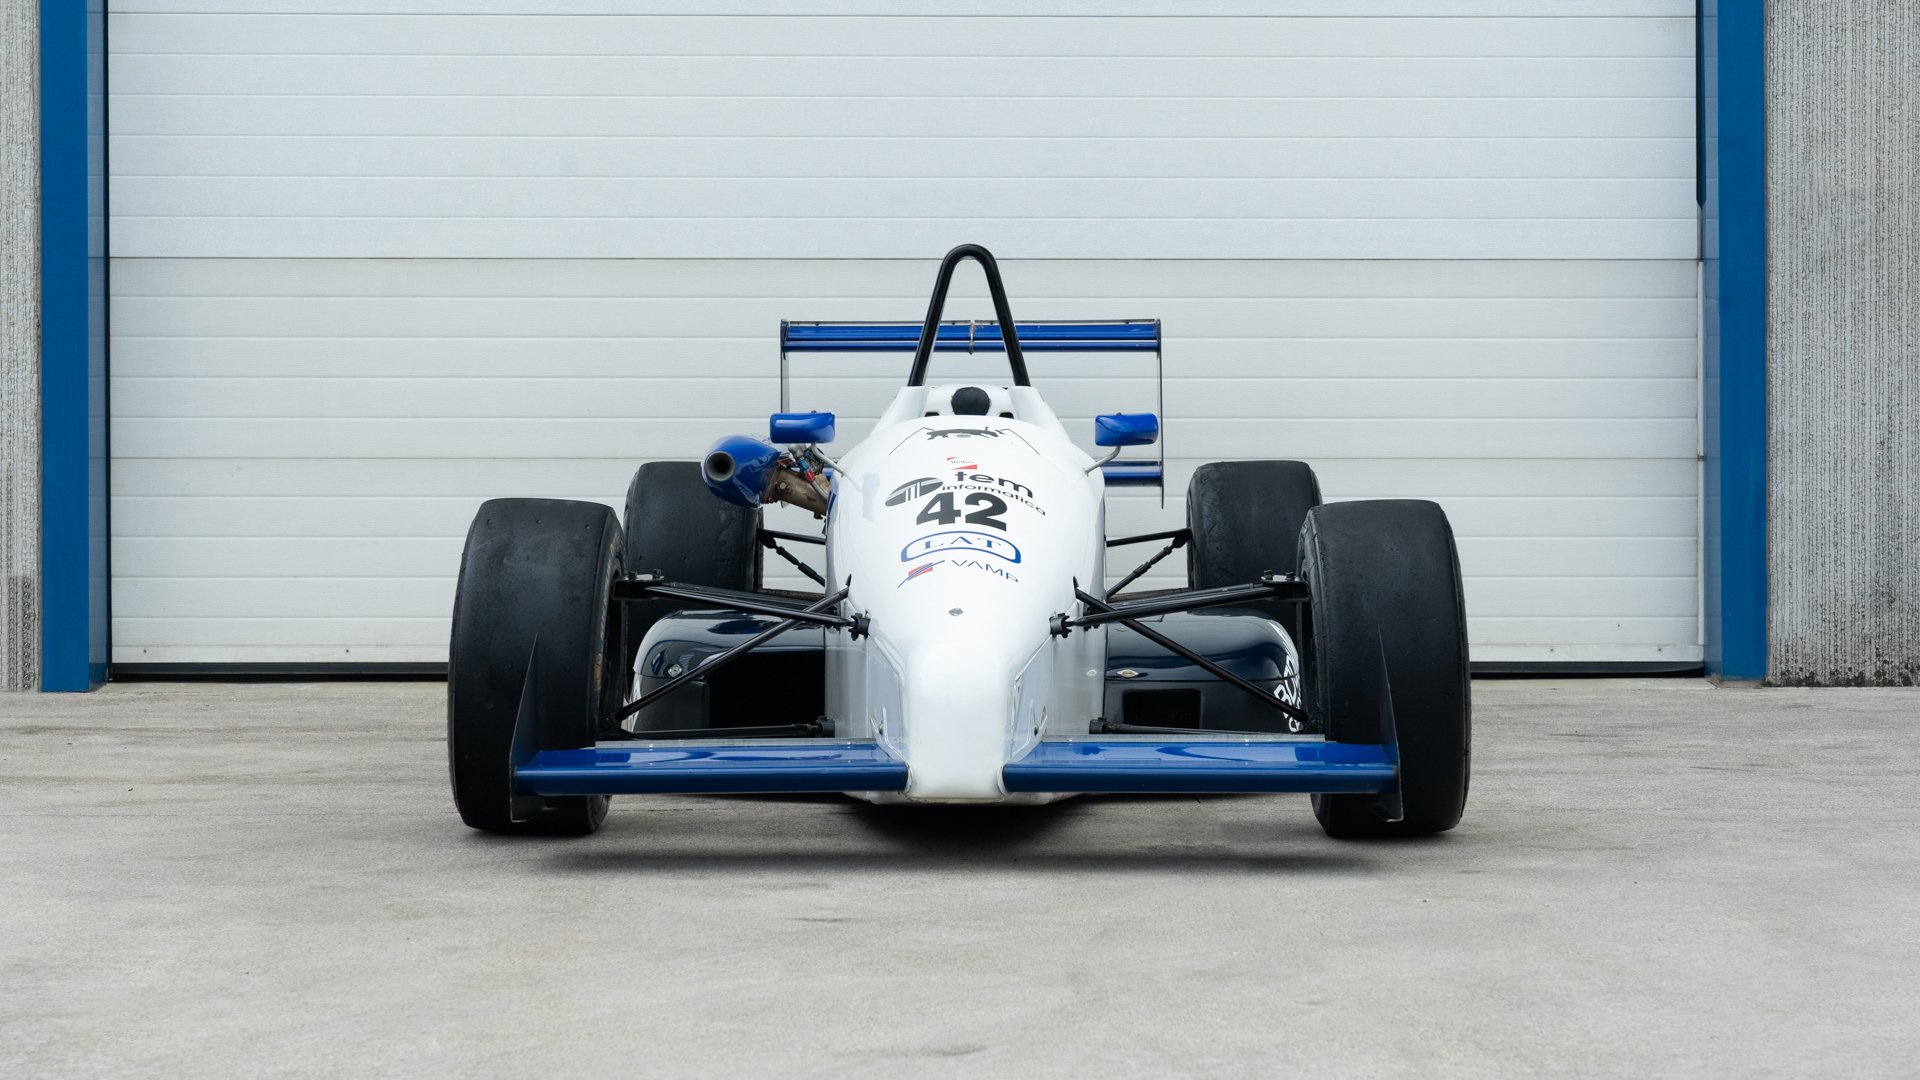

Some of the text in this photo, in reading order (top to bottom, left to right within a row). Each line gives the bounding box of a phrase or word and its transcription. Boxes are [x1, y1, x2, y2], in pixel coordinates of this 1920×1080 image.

[955, 471, 1034, 499] tem
[916, 492, 1008, 532] 42
[942, 484, 1046, 516] informatica
[922, 536, 1002, 550] LAT
[951, 559, 1019, 583] VAMP
